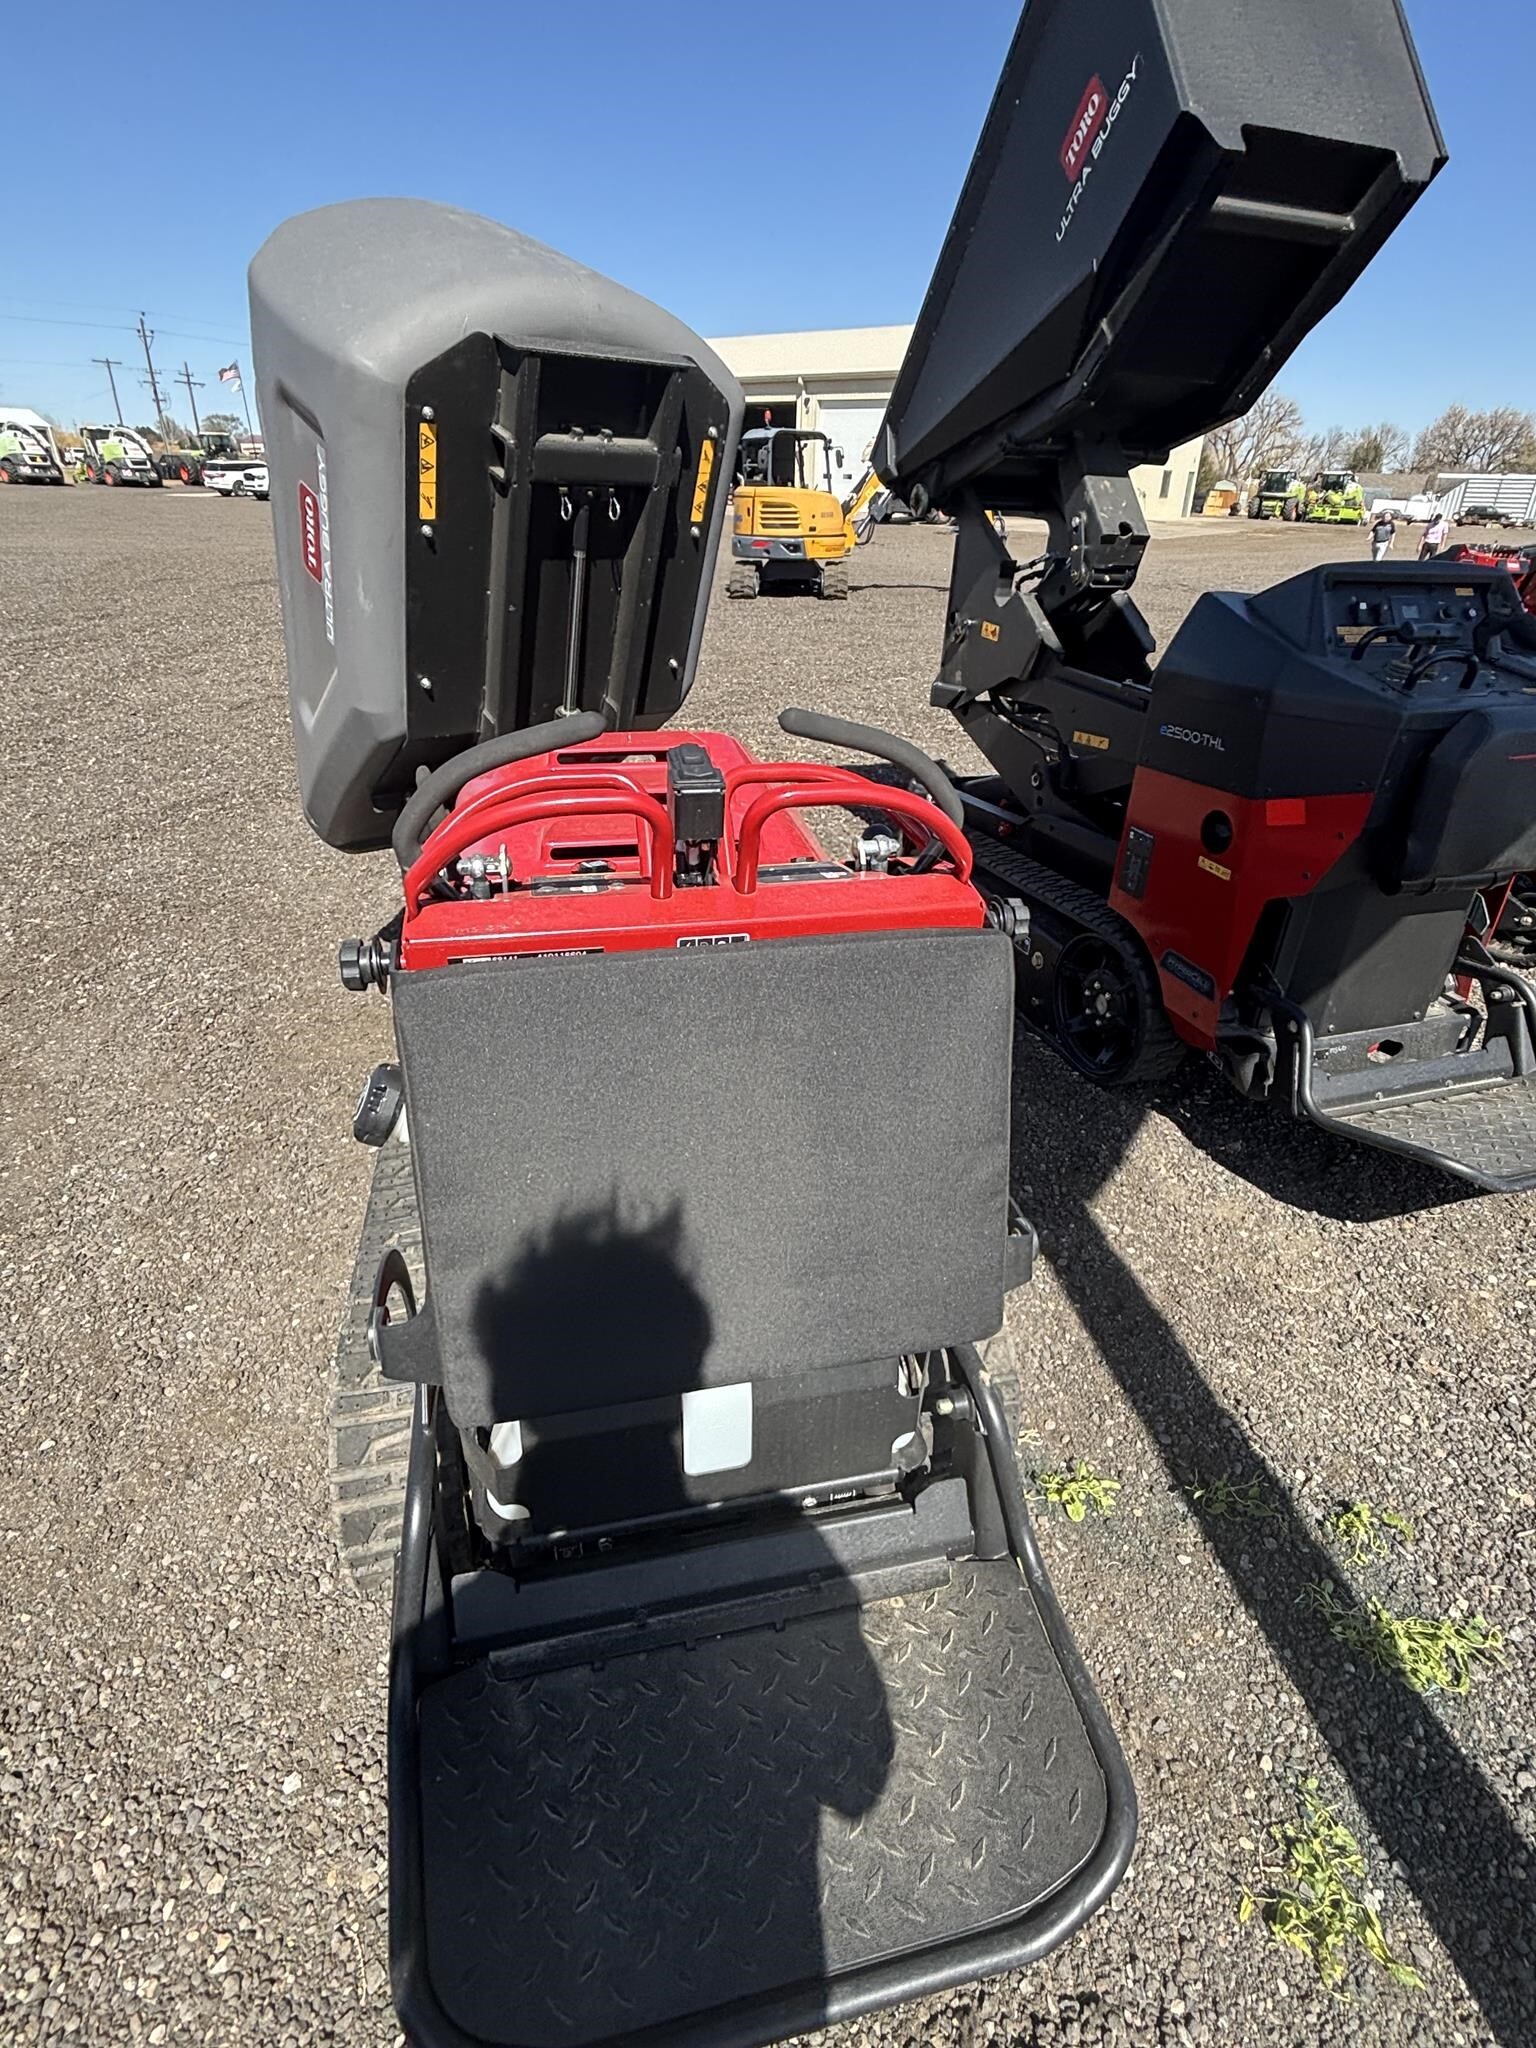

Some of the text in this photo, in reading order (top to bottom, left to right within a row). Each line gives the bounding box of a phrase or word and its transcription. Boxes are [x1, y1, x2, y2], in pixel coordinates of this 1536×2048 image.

[1055, 51, 1144, 242] ULTRA BUGGY
[1065, 93, 1101, 166] TORO
